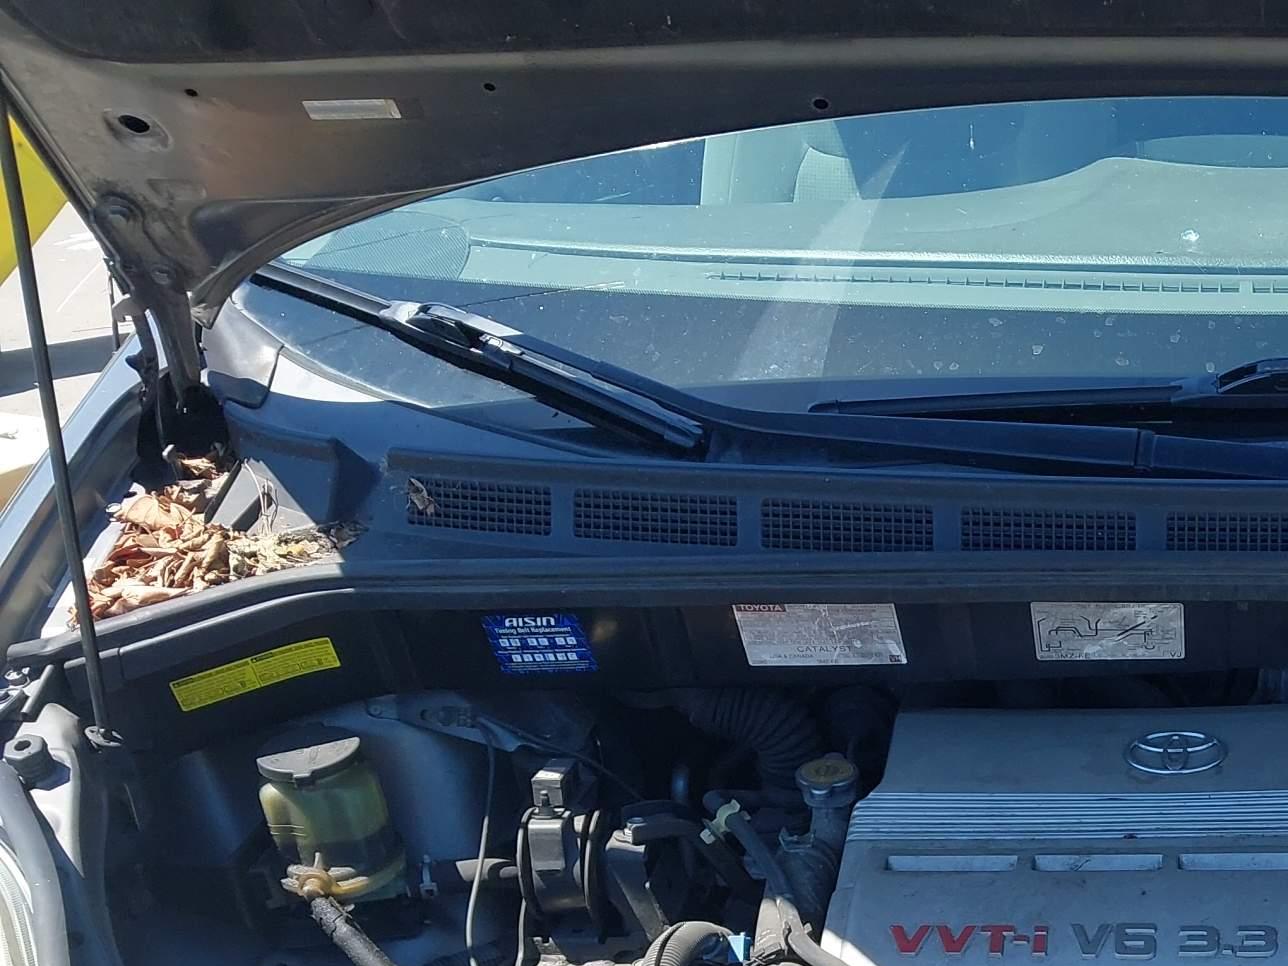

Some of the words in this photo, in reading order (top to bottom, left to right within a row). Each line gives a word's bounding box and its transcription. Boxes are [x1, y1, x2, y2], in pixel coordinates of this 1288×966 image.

[739, 604, 784, 612] TOYOTA
[504, 617, 555, 627] AISIN
[530, 626, 572, 634] Replacement
[890, 924, 1048, 958] VVT-i
[1071, 923, 1158, 959] V6
[1178, 924, 1279, 959] 3.3
